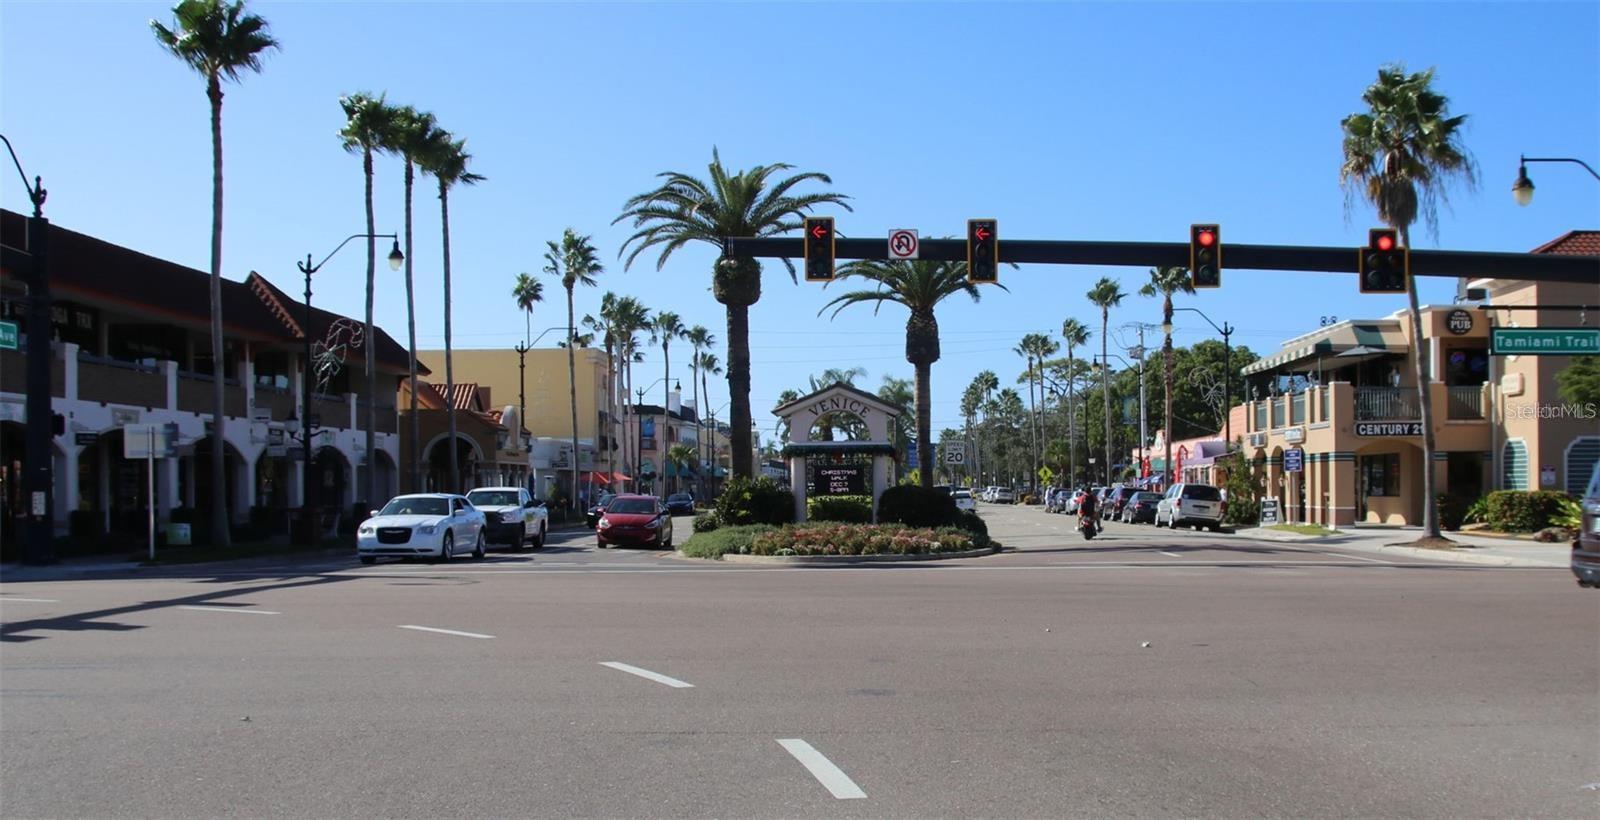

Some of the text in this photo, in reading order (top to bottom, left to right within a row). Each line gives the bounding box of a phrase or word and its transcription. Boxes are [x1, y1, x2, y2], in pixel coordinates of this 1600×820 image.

[1450, 320, 1472, 330] PUB
[1496, 335, 1600, 347] Tamiami Trail
[808, 397, 870, 418] VENICE
[1358, 423, 1410, 435] CENTURY
[947, 452, 963, 462] 20
